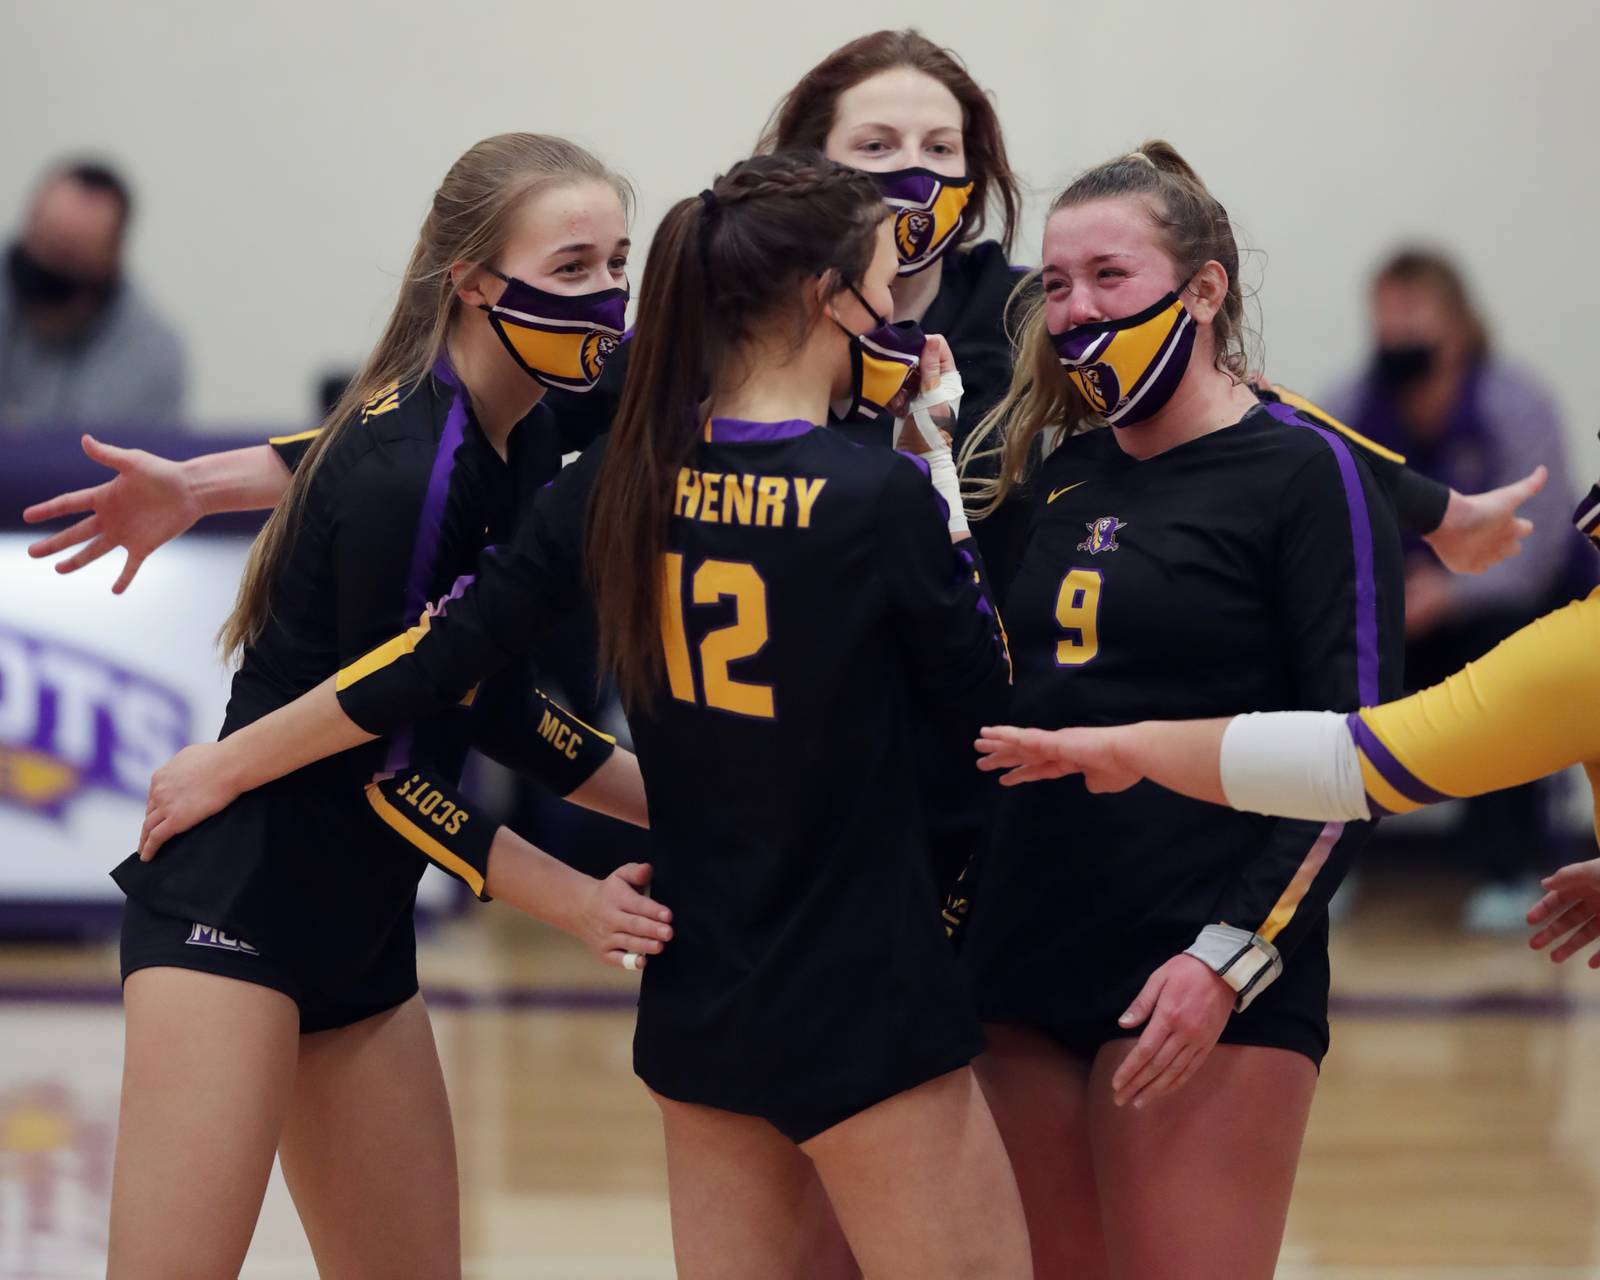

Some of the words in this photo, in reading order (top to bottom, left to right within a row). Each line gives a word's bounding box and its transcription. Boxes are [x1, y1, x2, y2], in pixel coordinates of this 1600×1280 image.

[659, 552, 775, 719] 12
[1054, 568, 1103, 666] 9
[536, 708, 583, 759] MCC
[395, 774, 469, 835] SCOTS
